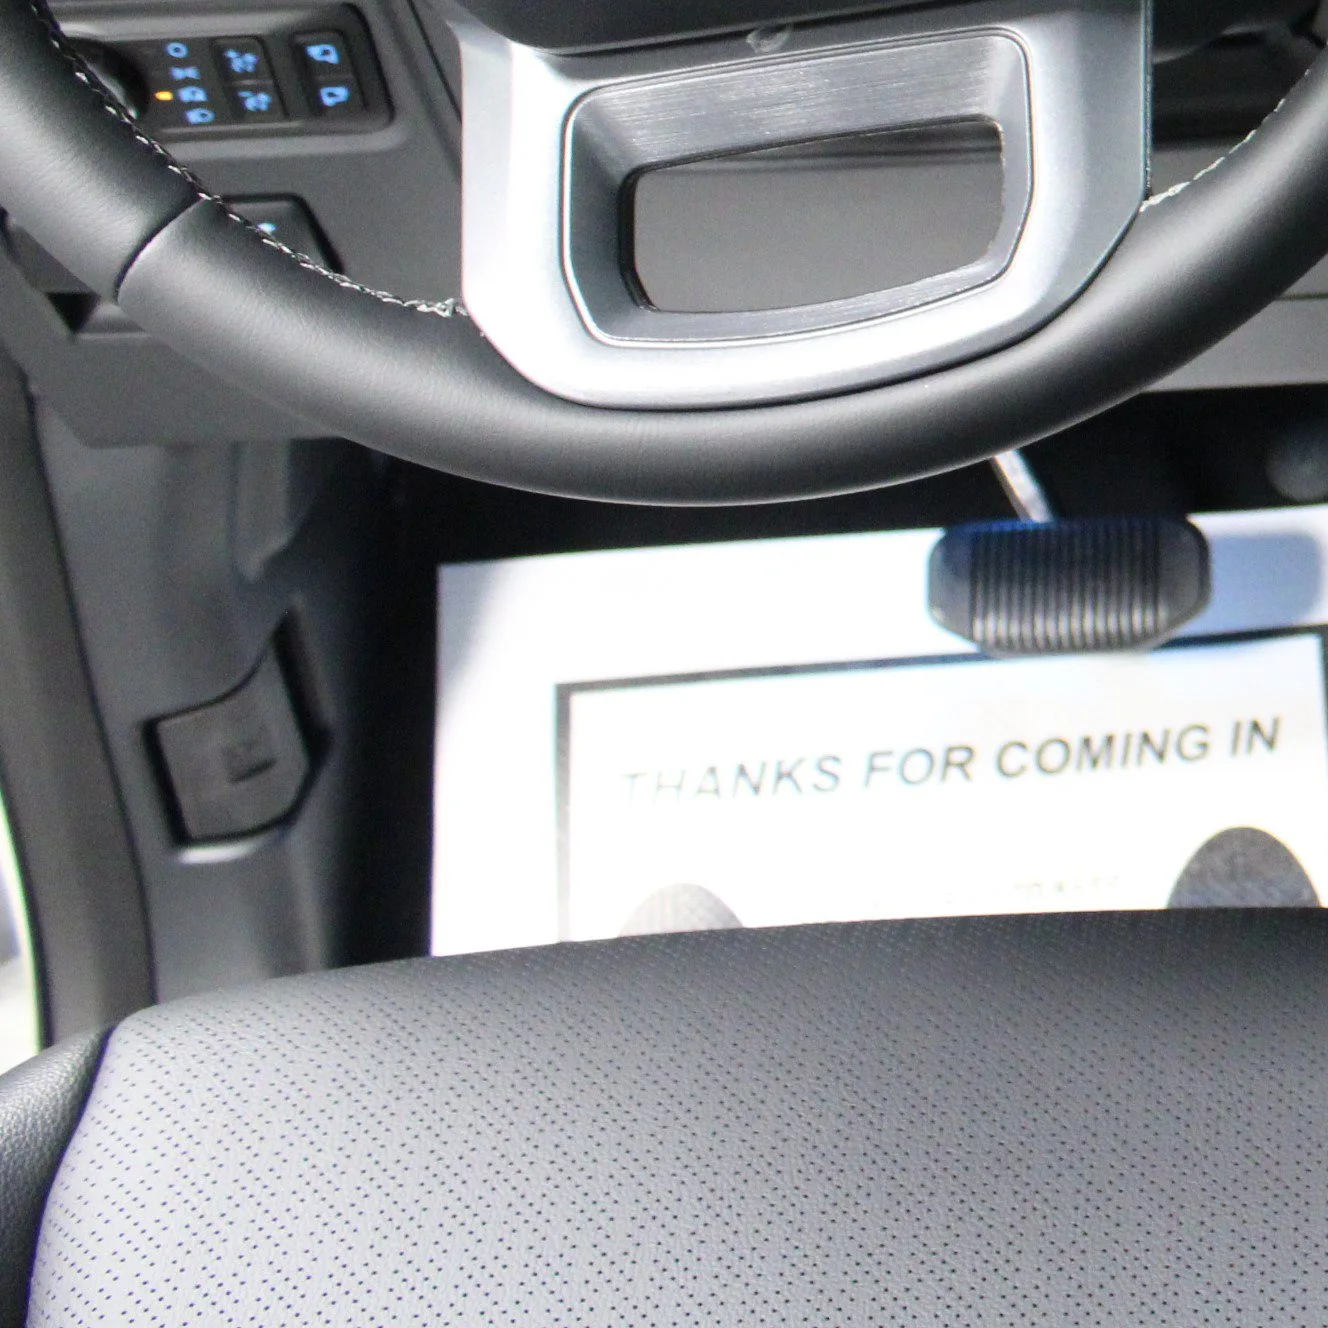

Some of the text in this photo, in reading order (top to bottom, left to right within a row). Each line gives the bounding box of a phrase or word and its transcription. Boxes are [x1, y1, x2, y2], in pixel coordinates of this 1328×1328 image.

[620, 716, 1284, 806] THANKS FOR COMING IN
